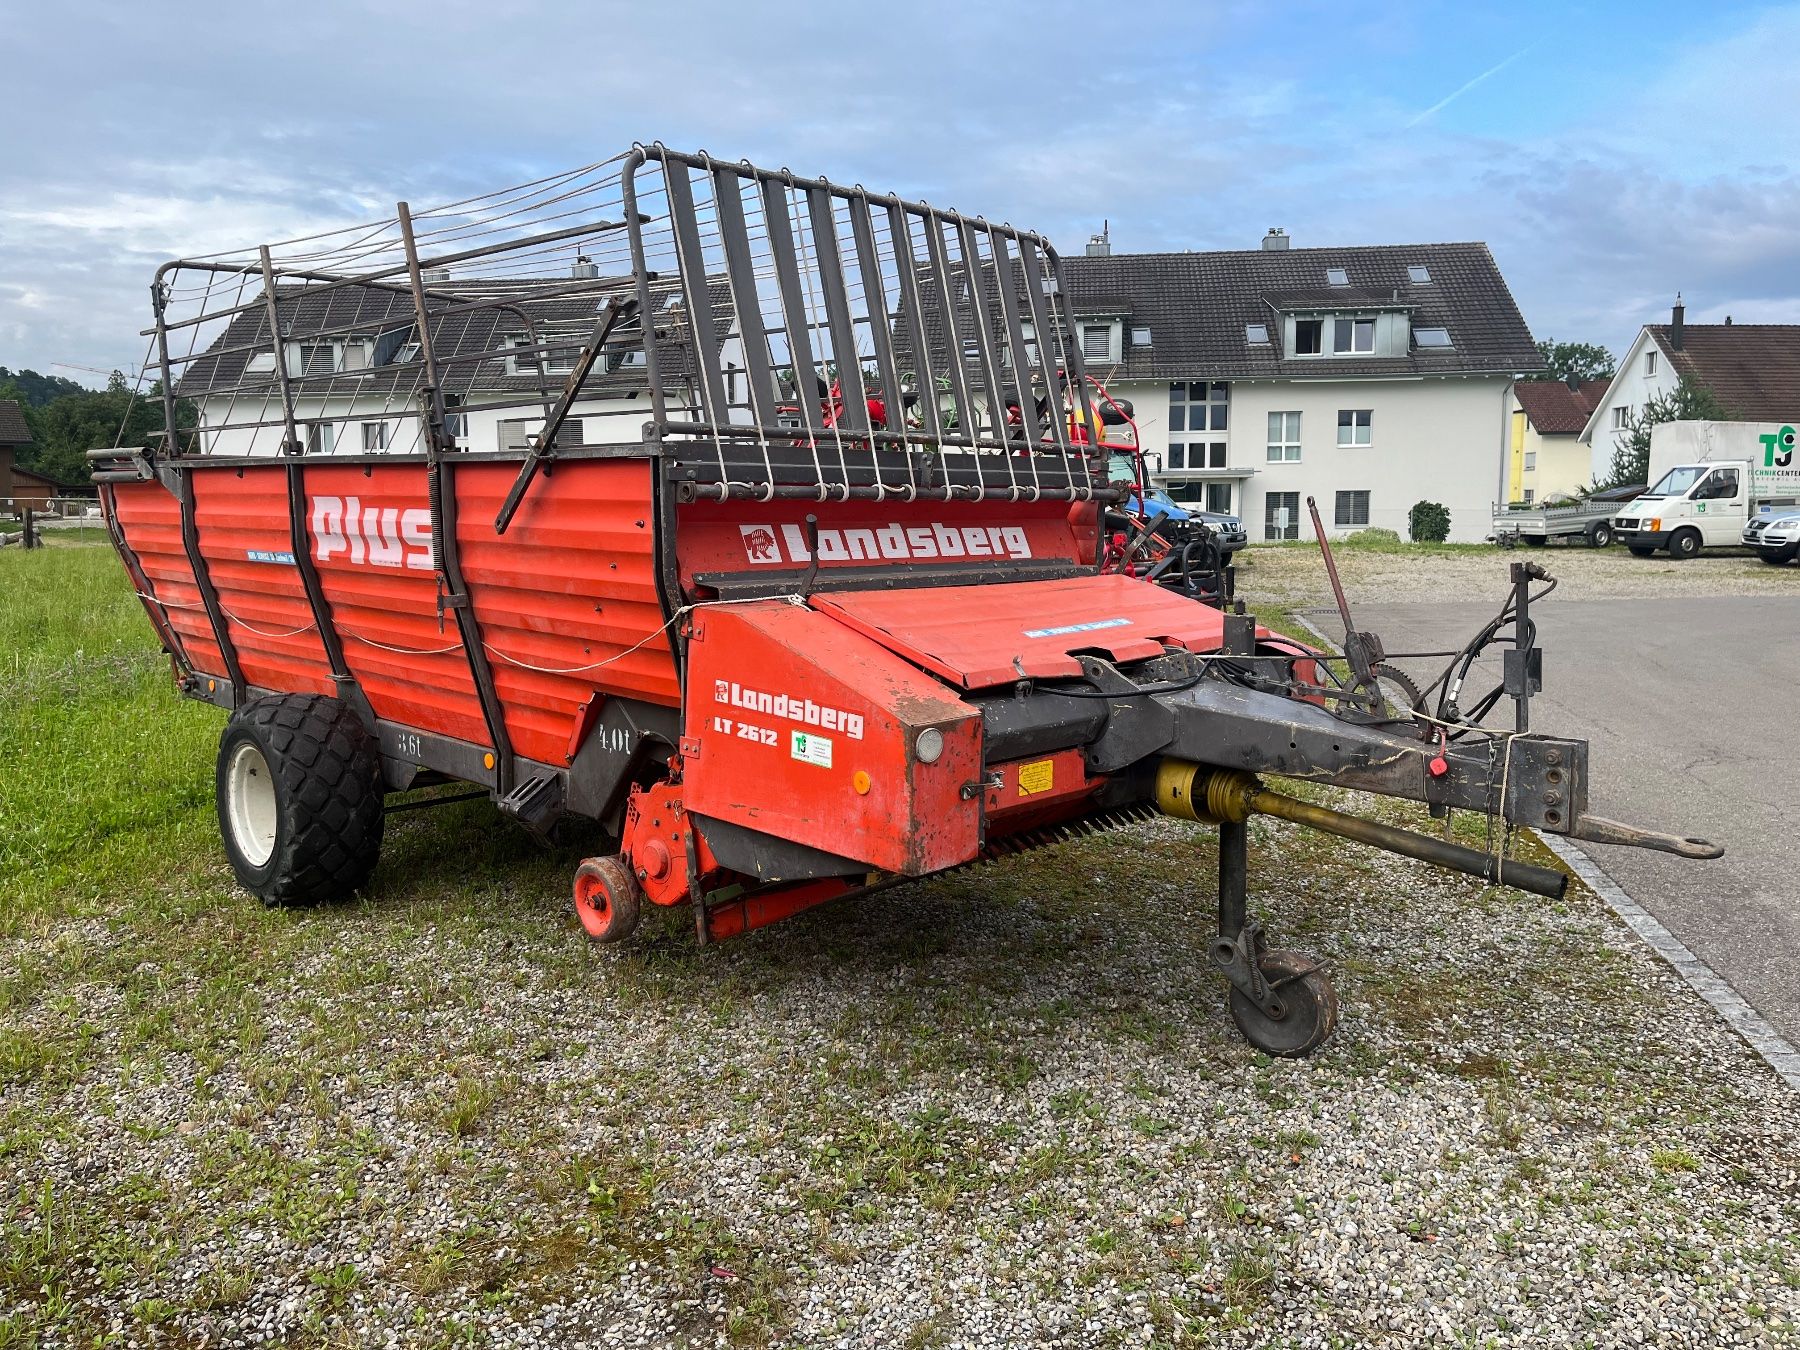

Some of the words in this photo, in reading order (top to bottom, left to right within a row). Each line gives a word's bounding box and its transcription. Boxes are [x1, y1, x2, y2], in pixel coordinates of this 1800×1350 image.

[1747, 469, 1800, 477] TCHNIKCENTE
[781, 523, 1031, 560] Landsberg
[731, 682, 864, 740] Landsberg
[713, 716, 733, 735] LT
[737, 722, 778, 747] 2612
